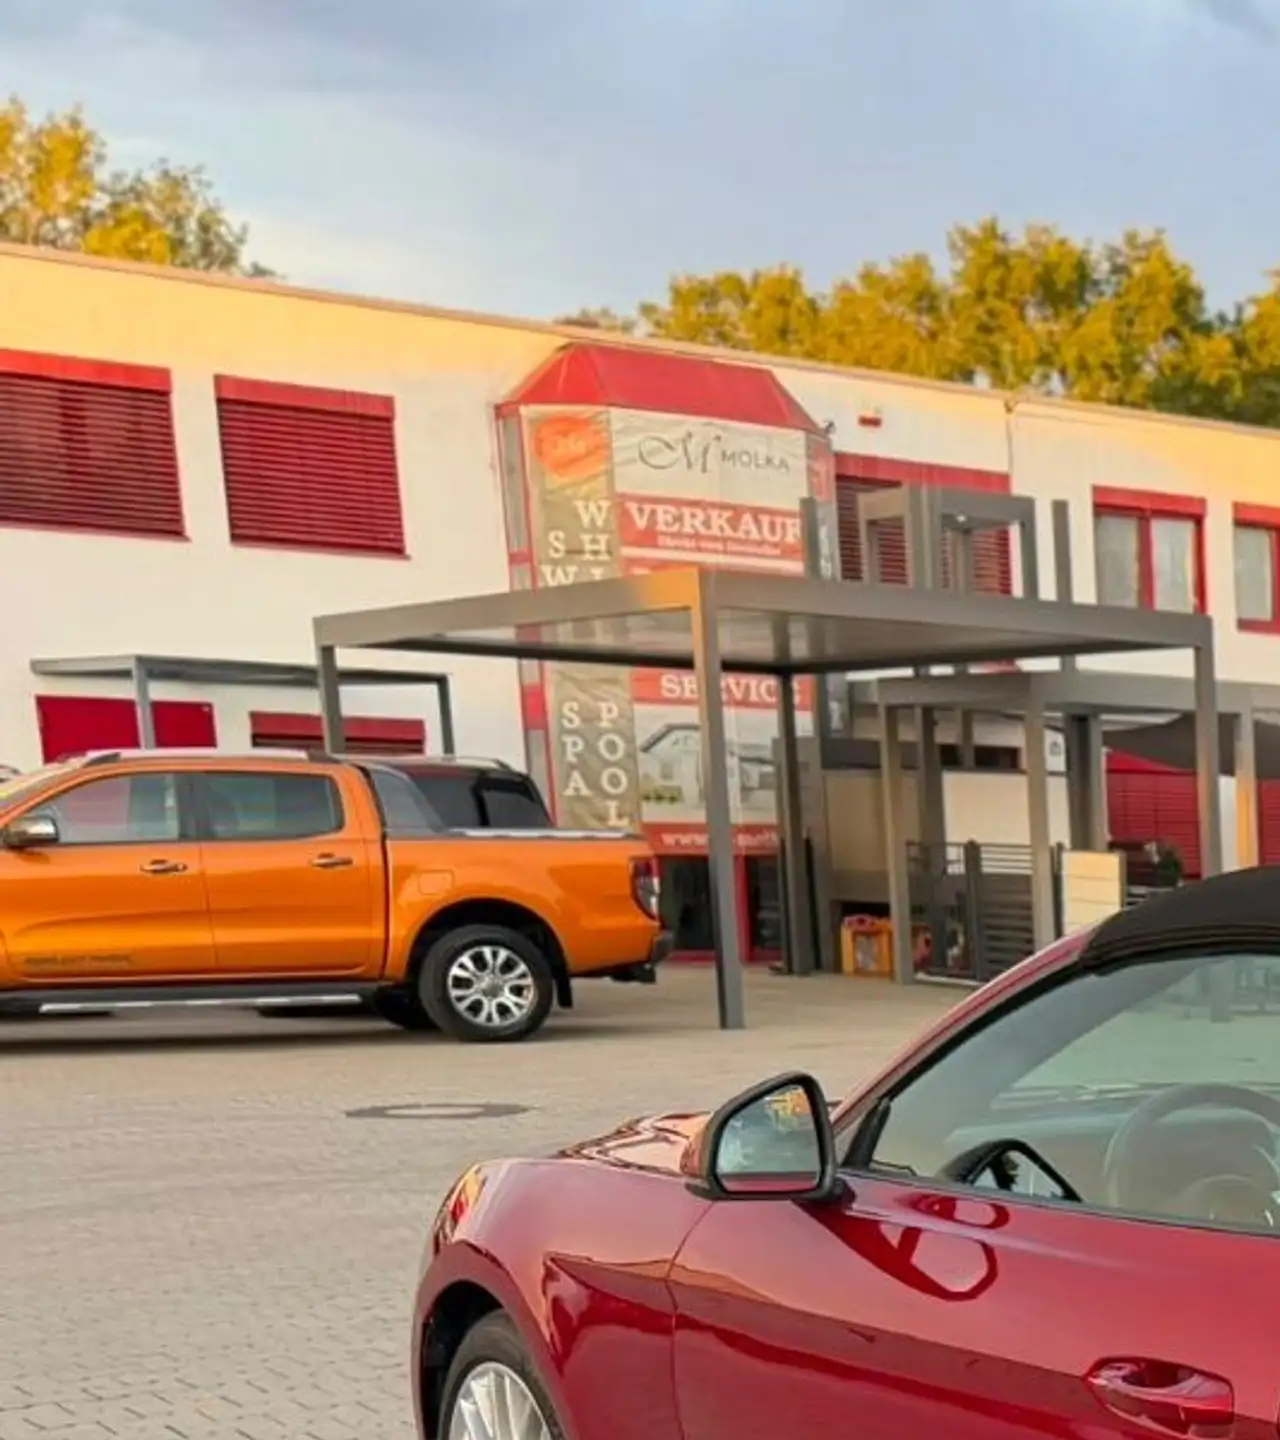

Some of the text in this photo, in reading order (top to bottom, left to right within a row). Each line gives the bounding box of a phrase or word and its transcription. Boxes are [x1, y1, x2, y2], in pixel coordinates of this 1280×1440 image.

[721, 448, 790, 474] MOLKA
[661, 674, 800, 706] SEVIC
[561, 701, 593, 796] SPA
[597, 701, 629, 827] POOL
